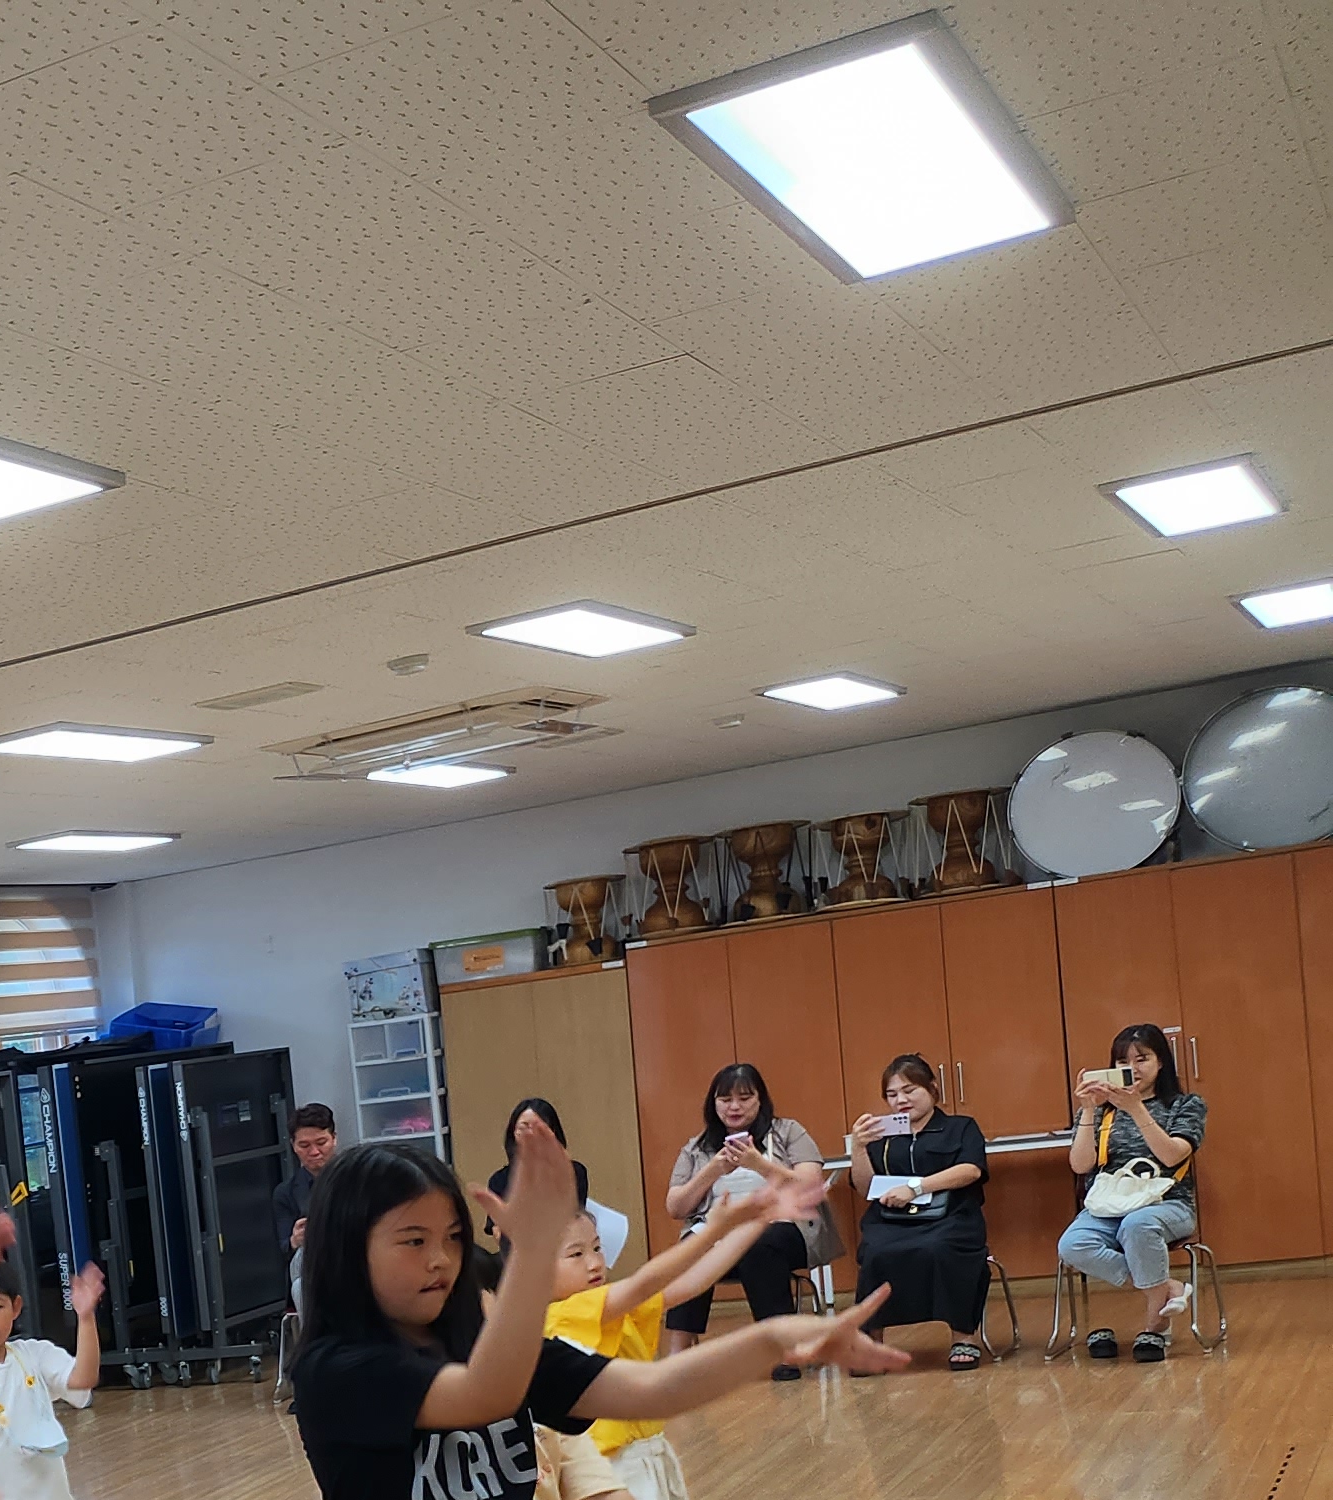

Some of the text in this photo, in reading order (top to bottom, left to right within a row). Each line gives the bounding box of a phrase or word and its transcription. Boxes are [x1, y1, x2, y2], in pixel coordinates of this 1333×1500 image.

[175, 1082, 187, 1130] CHAMPION
[42, 1104, 58, 1174] CHAMPION
[58, 1252, 70, 1287] SUPER
